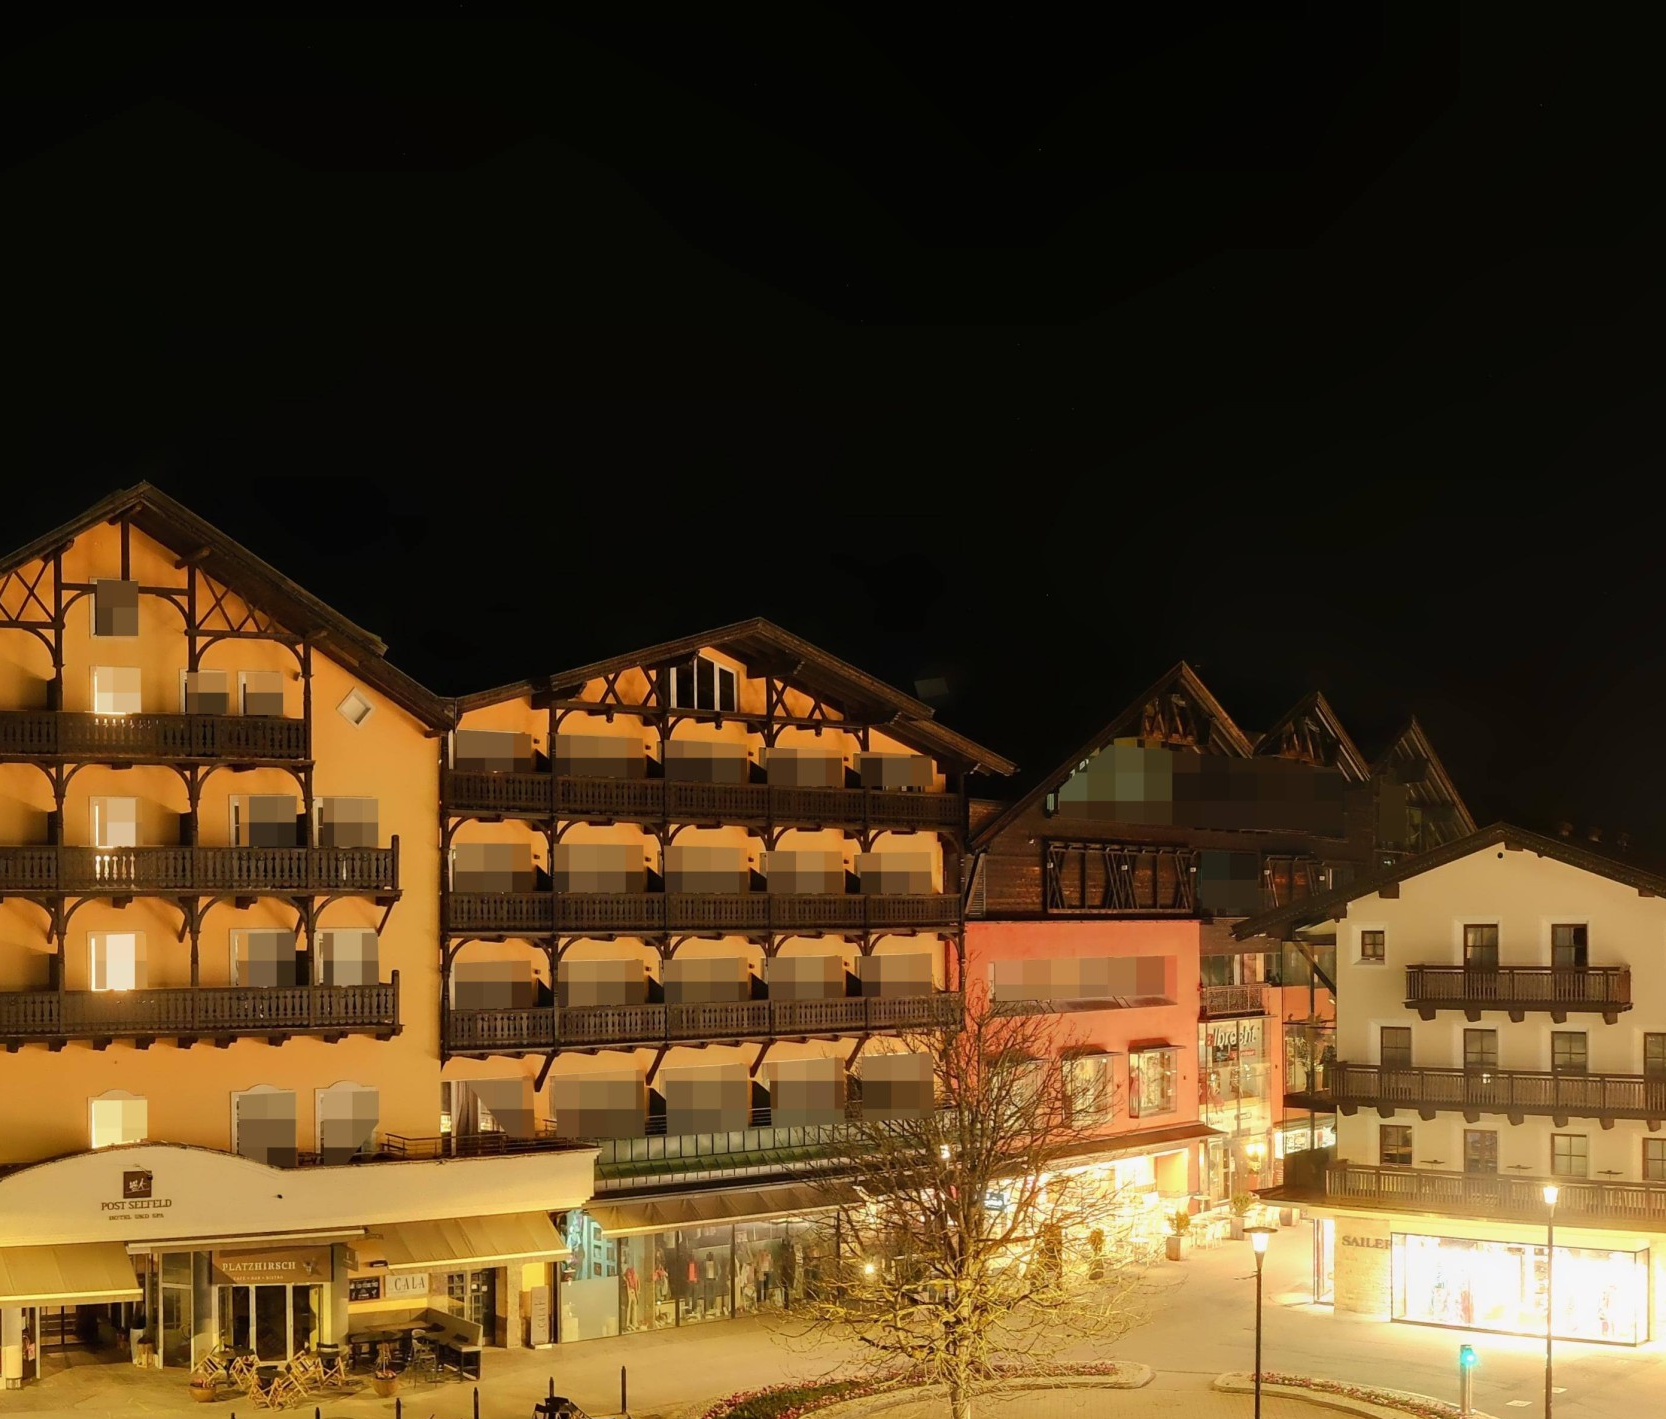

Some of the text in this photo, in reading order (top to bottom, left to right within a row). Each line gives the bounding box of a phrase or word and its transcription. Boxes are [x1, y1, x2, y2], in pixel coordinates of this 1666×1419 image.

[101, 1199, 172, 1211] POST SEEFELD
[222, 1261, 296, 1272] PLATZHIRSCH
